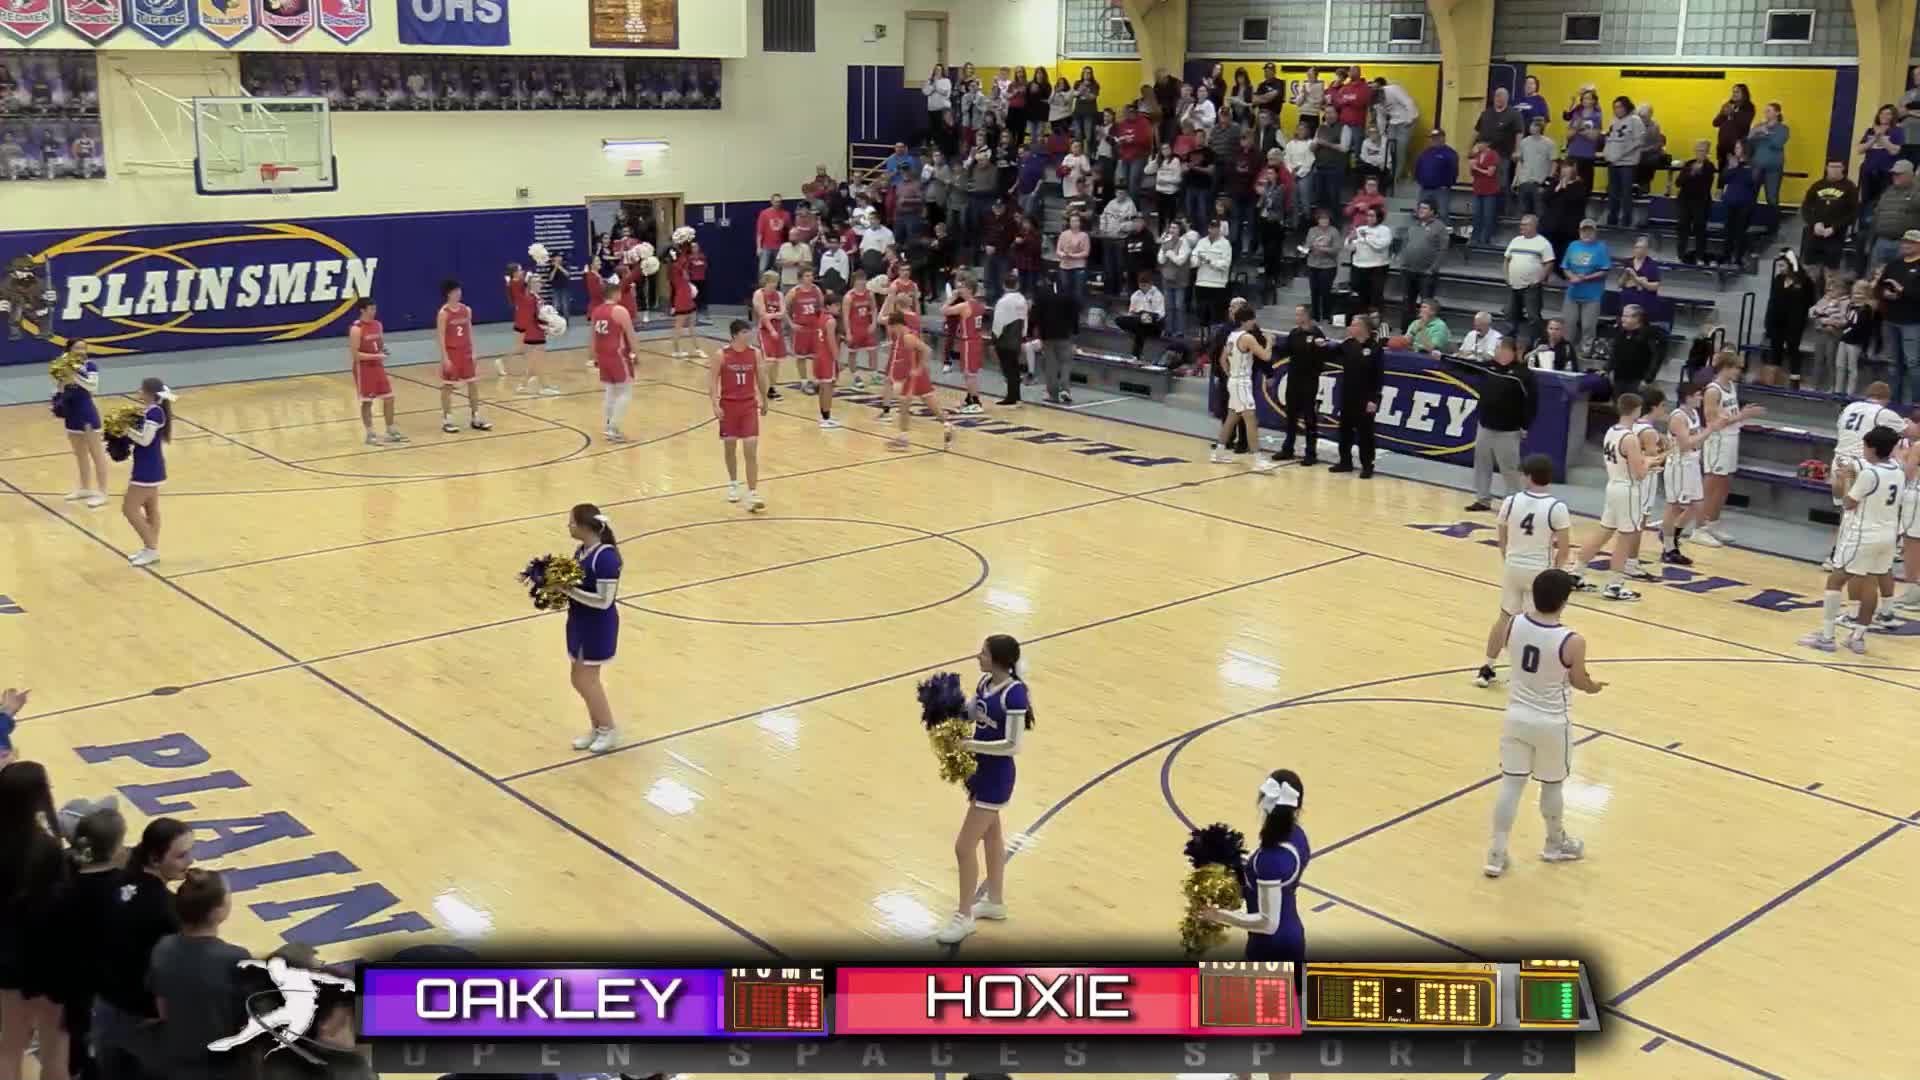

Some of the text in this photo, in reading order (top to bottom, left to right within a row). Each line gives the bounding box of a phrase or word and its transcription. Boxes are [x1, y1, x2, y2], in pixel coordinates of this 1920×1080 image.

[412, 0, 502, 24] OHS
[61, 257, 378, 320] PLAINSMEN
[594, 319, 609, 335] 42
[735, 372, 747, 385] 11
[1277, 371, 1478, 438] ALEY
[1844, 412, 1865, 432] 21
[1885, 484, 1898, 506] 3
[1519, 512, 1536, 537] 4
[1521, 643, 1541, 674] 0
[72, 732, 435, 965] PLAIN
